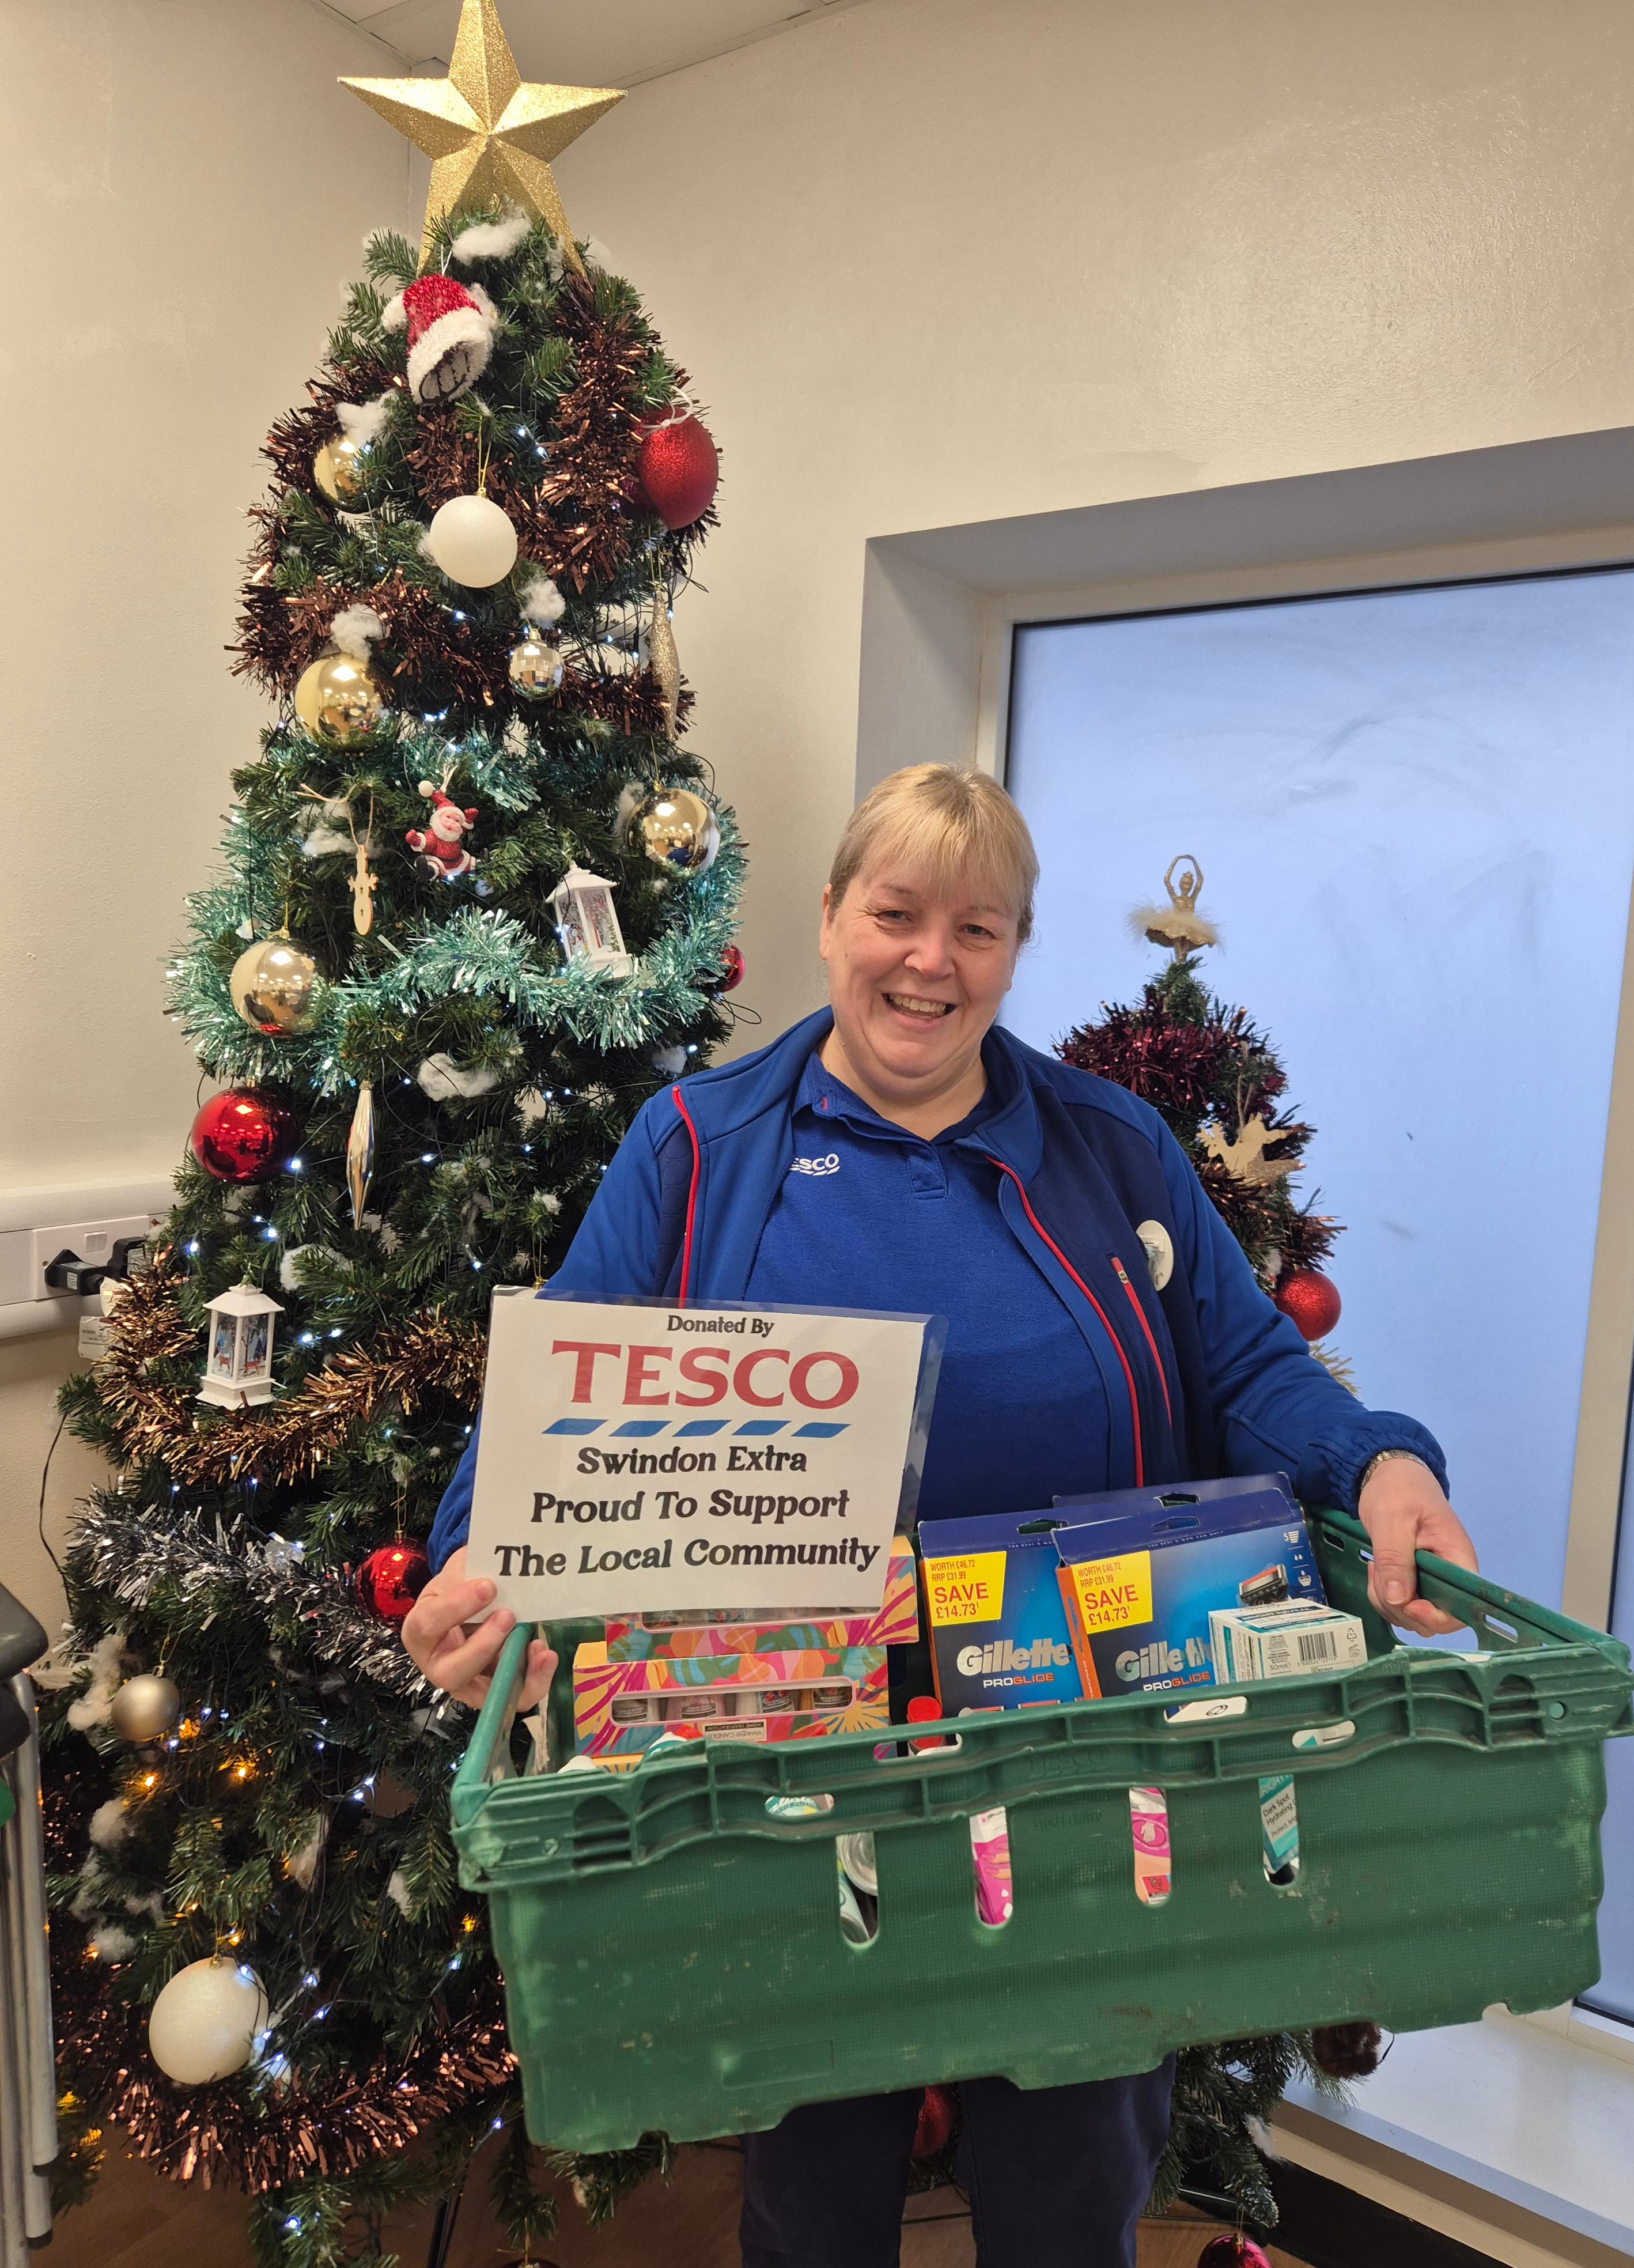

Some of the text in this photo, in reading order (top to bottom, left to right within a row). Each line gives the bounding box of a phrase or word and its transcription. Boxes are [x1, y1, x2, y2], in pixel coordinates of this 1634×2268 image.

[667, 1315, 774, 1337] Donated By
[551, 1340, 859, 1409] TESCO
[577, 1445, 807, 1474] Swindon Extra
[531, 1489, 850, 1524] Proud To Support
[494, 1537, 881, 1577] The Local Community
[930, 1559, 976, 1571] WORTH £46.72
[932, 1571, 966, 1582] RRP £31.99
[1077, 1562, 1121, 1577] WORTH £46.72
[1080, 1574, 1114, 1589] RRP £31.99
[934, 1582, 989, 1604] SAVE
[1084, 1584, 1138, 1610] SAVE
[956, 1638, 1070, 1676] Gillette
[983, 1673, 1054, 1689] PROGLIDE
[1143, 1672, 1210, 1692] PROGLIDE
[1263, 1793, 1290, 1817] Dark Spot
